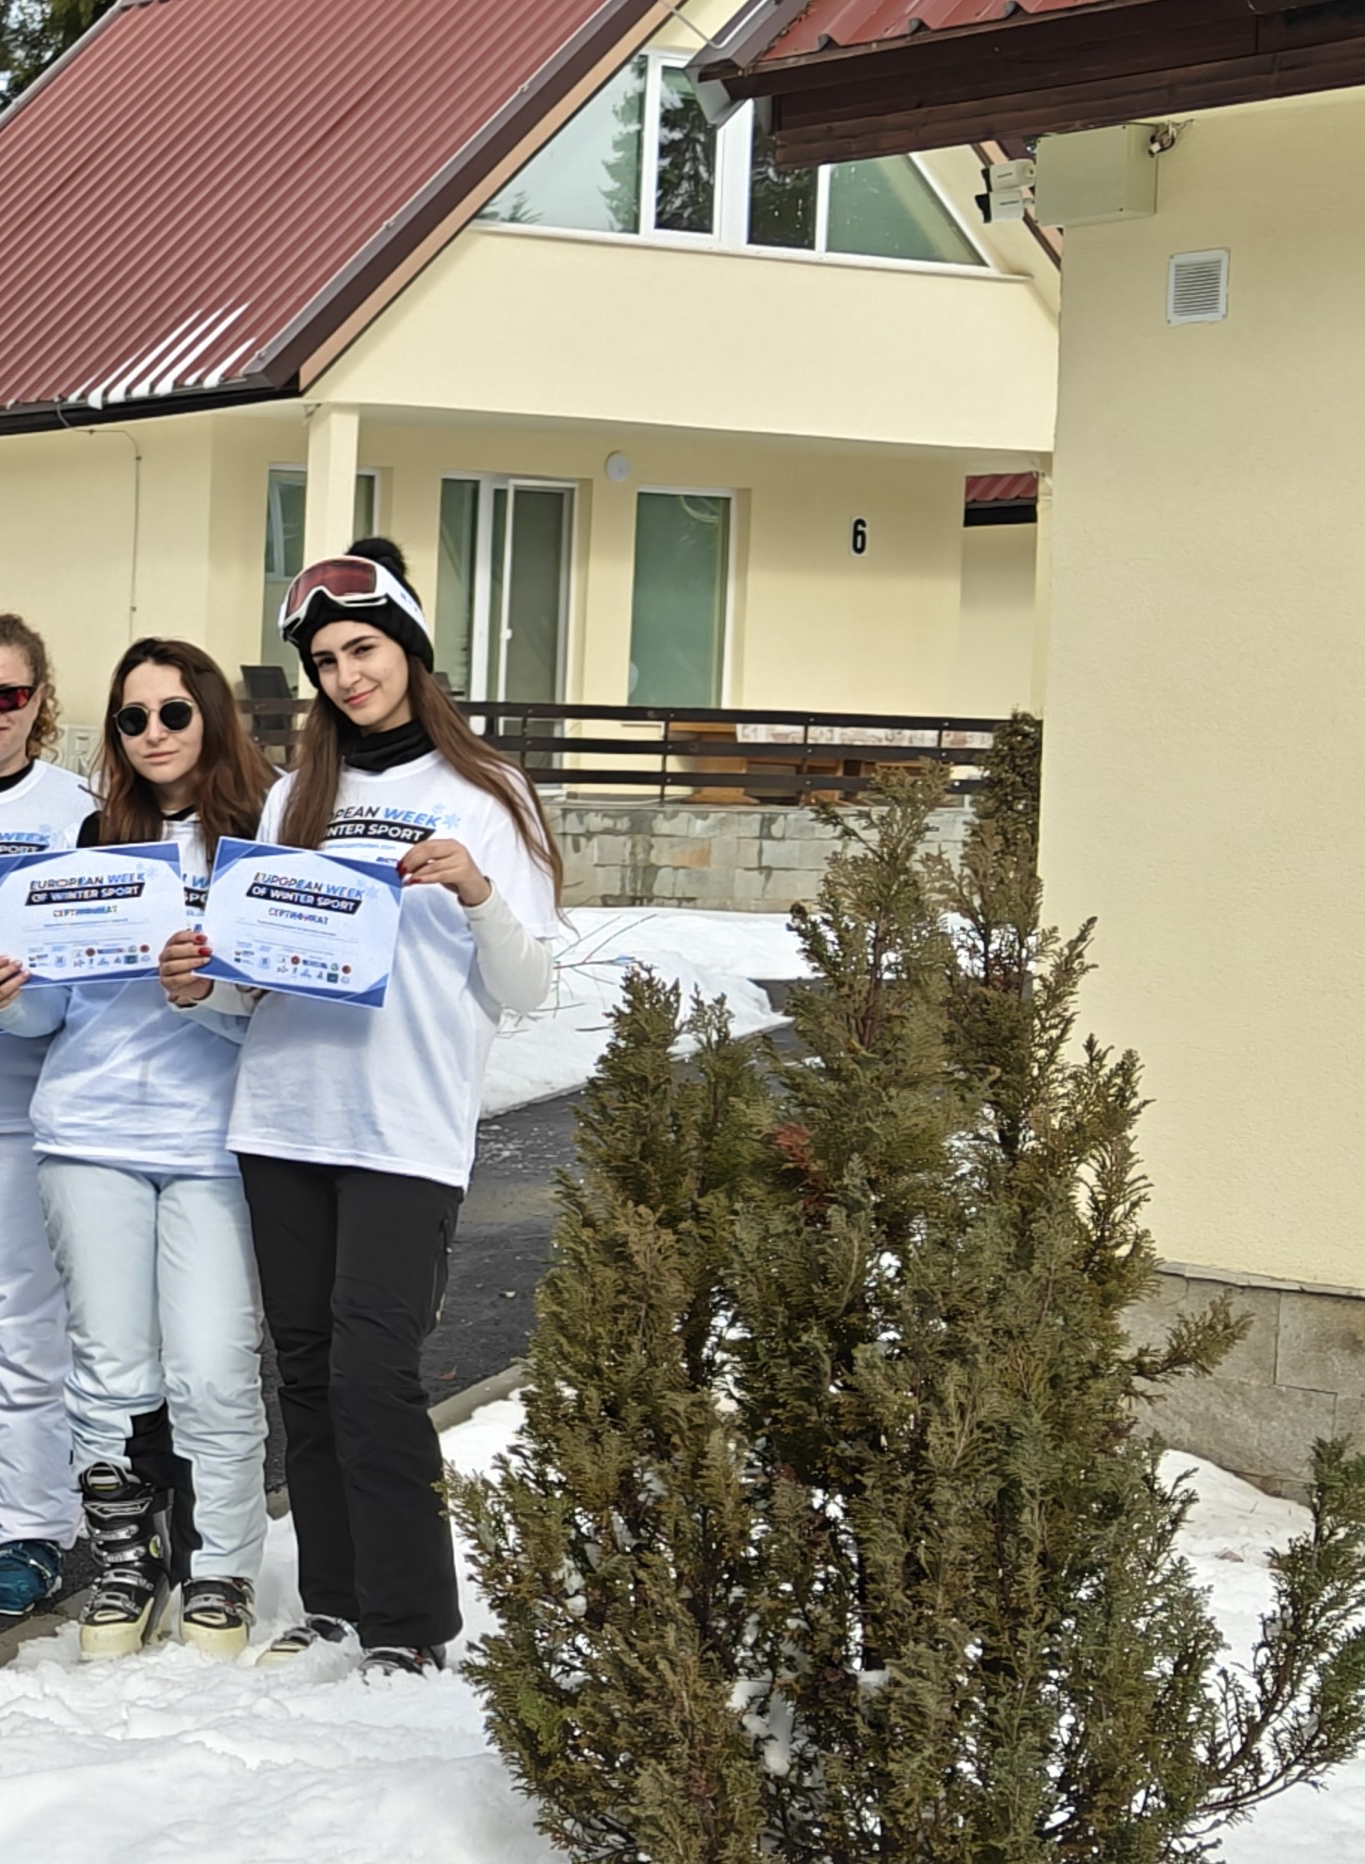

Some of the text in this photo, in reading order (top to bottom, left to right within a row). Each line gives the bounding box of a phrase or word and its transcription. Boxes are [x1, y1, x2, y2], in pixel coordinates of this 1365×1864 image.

[852, 518, 867, 554] 6
[384, 808, 442, 826] WEEK
[326, 824, 424, 841] NTER SPORT
[30, 873, 145, 890] EUROPEAN WEEK
[255, 873, 365, 899] EUROPEAN WEEK
[32, 886, 139, 902] OF WINTER SPORT
[252, 887, 355, 911] OF WINTER SPORT
